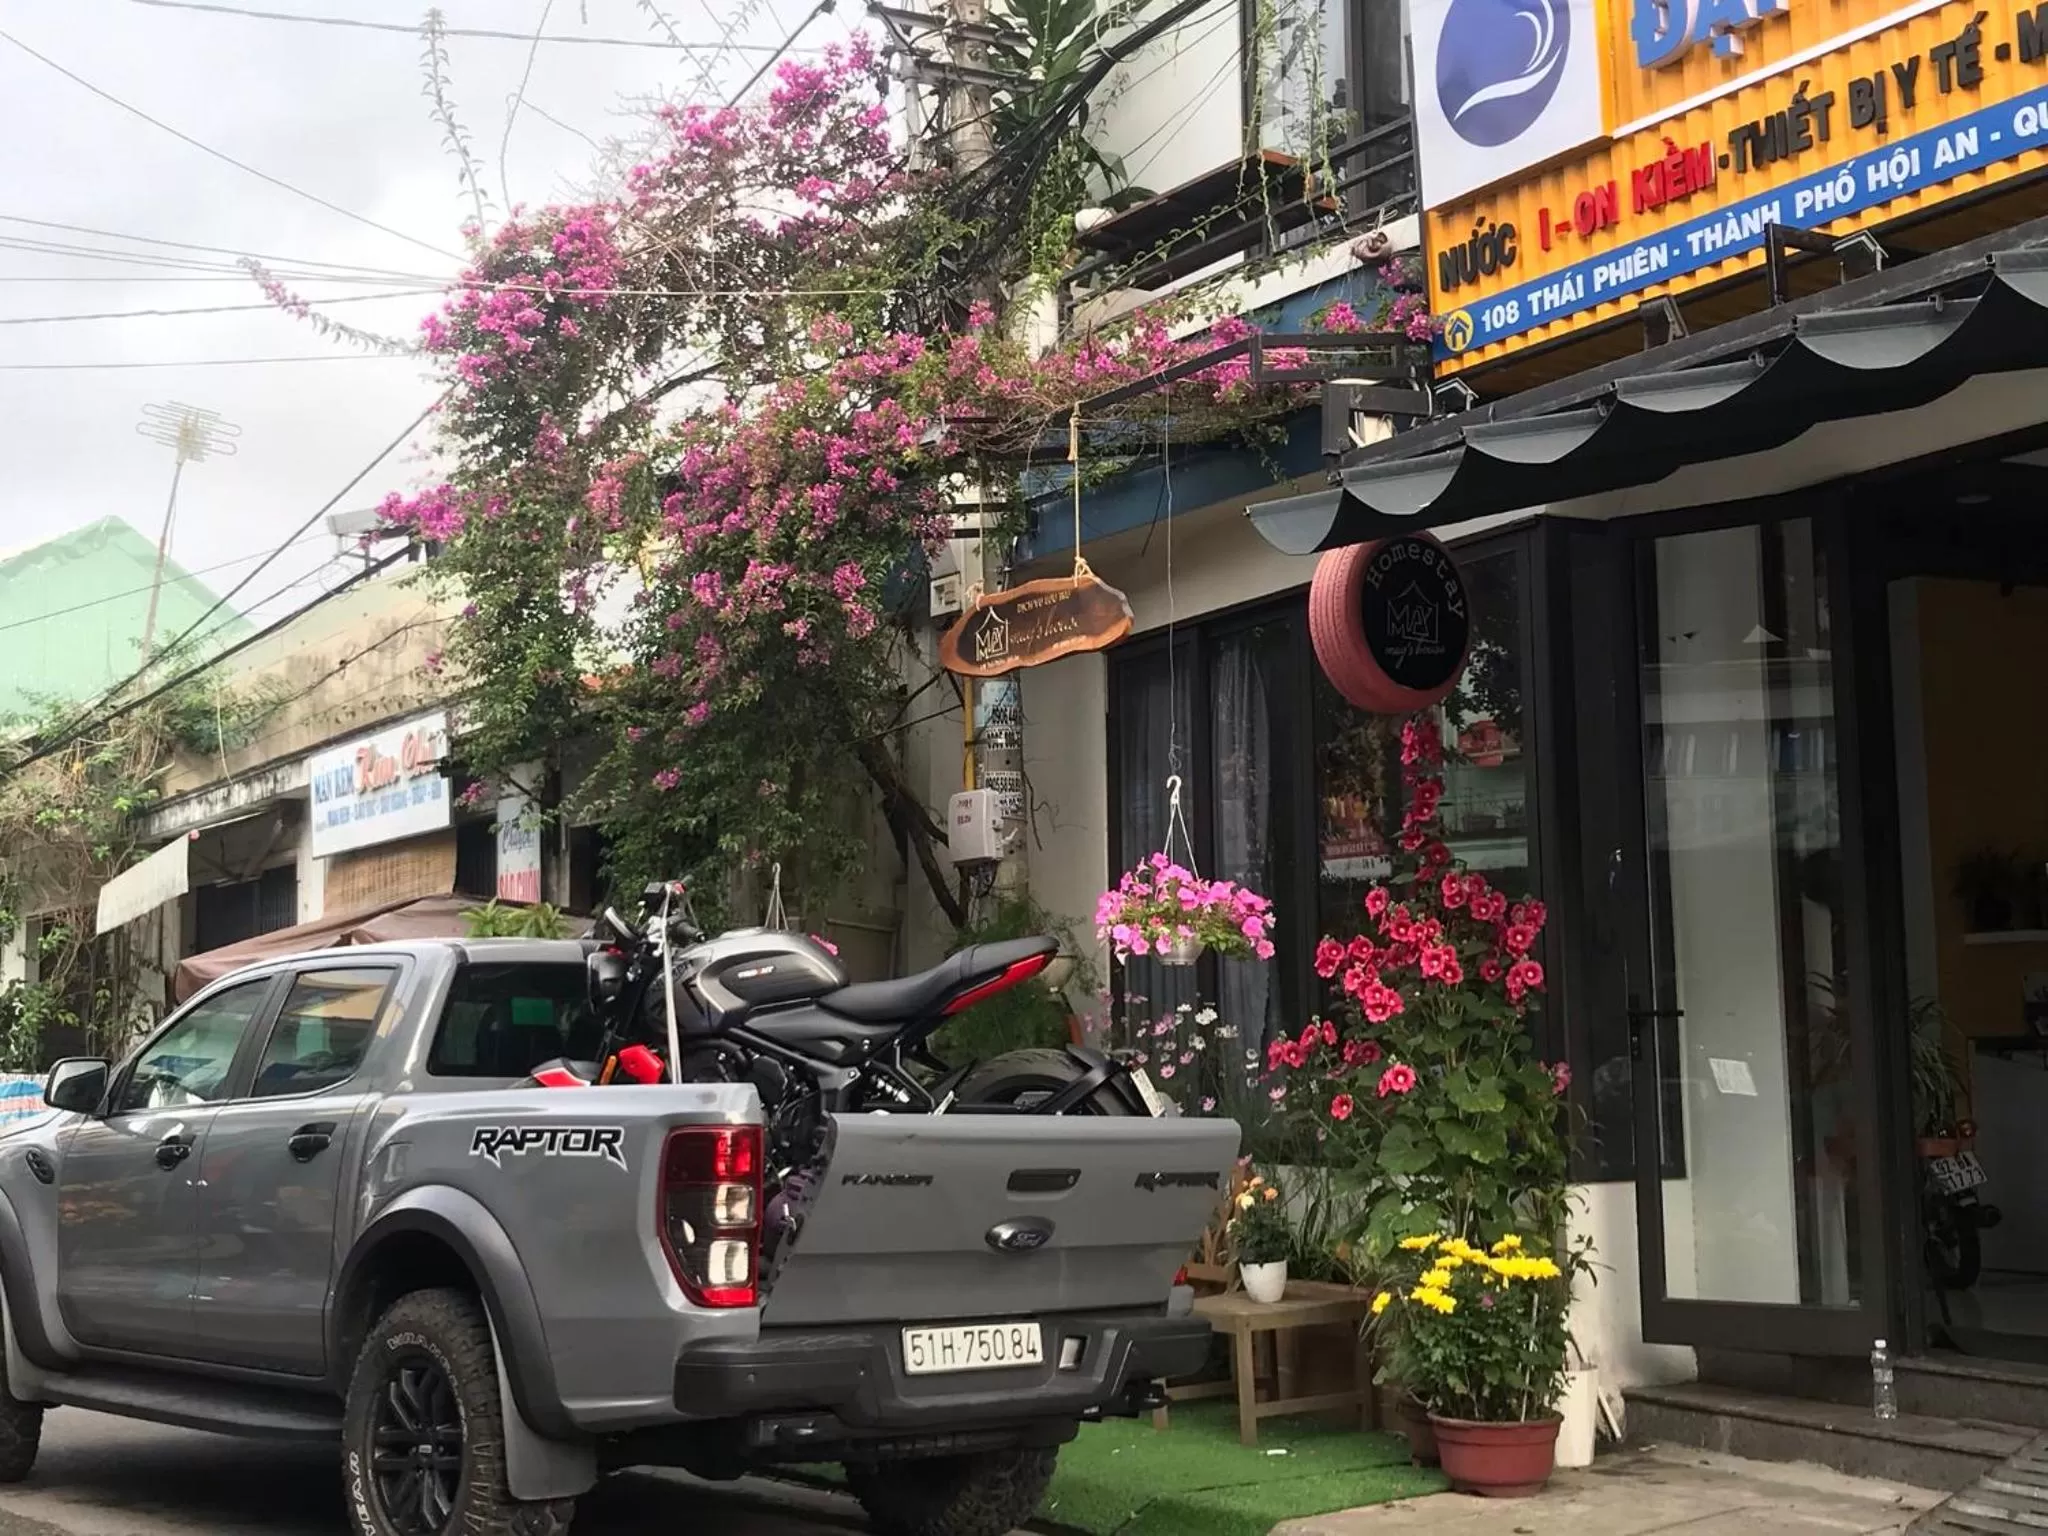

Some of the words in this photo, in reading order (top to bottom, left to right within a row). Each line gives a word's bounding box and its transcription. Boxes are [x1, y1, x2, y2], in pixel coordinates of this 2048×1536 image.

[1632, 0, 1790, 68] ĐẠ
[1438, 216, 1517, 292] NƯỚC
[1728, 79, 1836, 174] THIẾT
[1848, 71, 1888, 134] BỊ
[1891, 55, 1920, 109] Y
[1930, 10, 1984, 94] TẾ
[1481, 300, 1520, 333] 108
[1527, 272, 1585, 317] THÁI
[1593, 242, 1669, 293] PHIÊN
[1687, 201, 1781, 257] THÀNH
[1795, 160, 1855, 219] PHỐ
[1867, 146, 1921, 189] HỘI
[1934, 126, 1979, 169] AN
[1366, 542, 1465, 620] Homestay
[468, 1126, 629, 1174] RAPTOR
